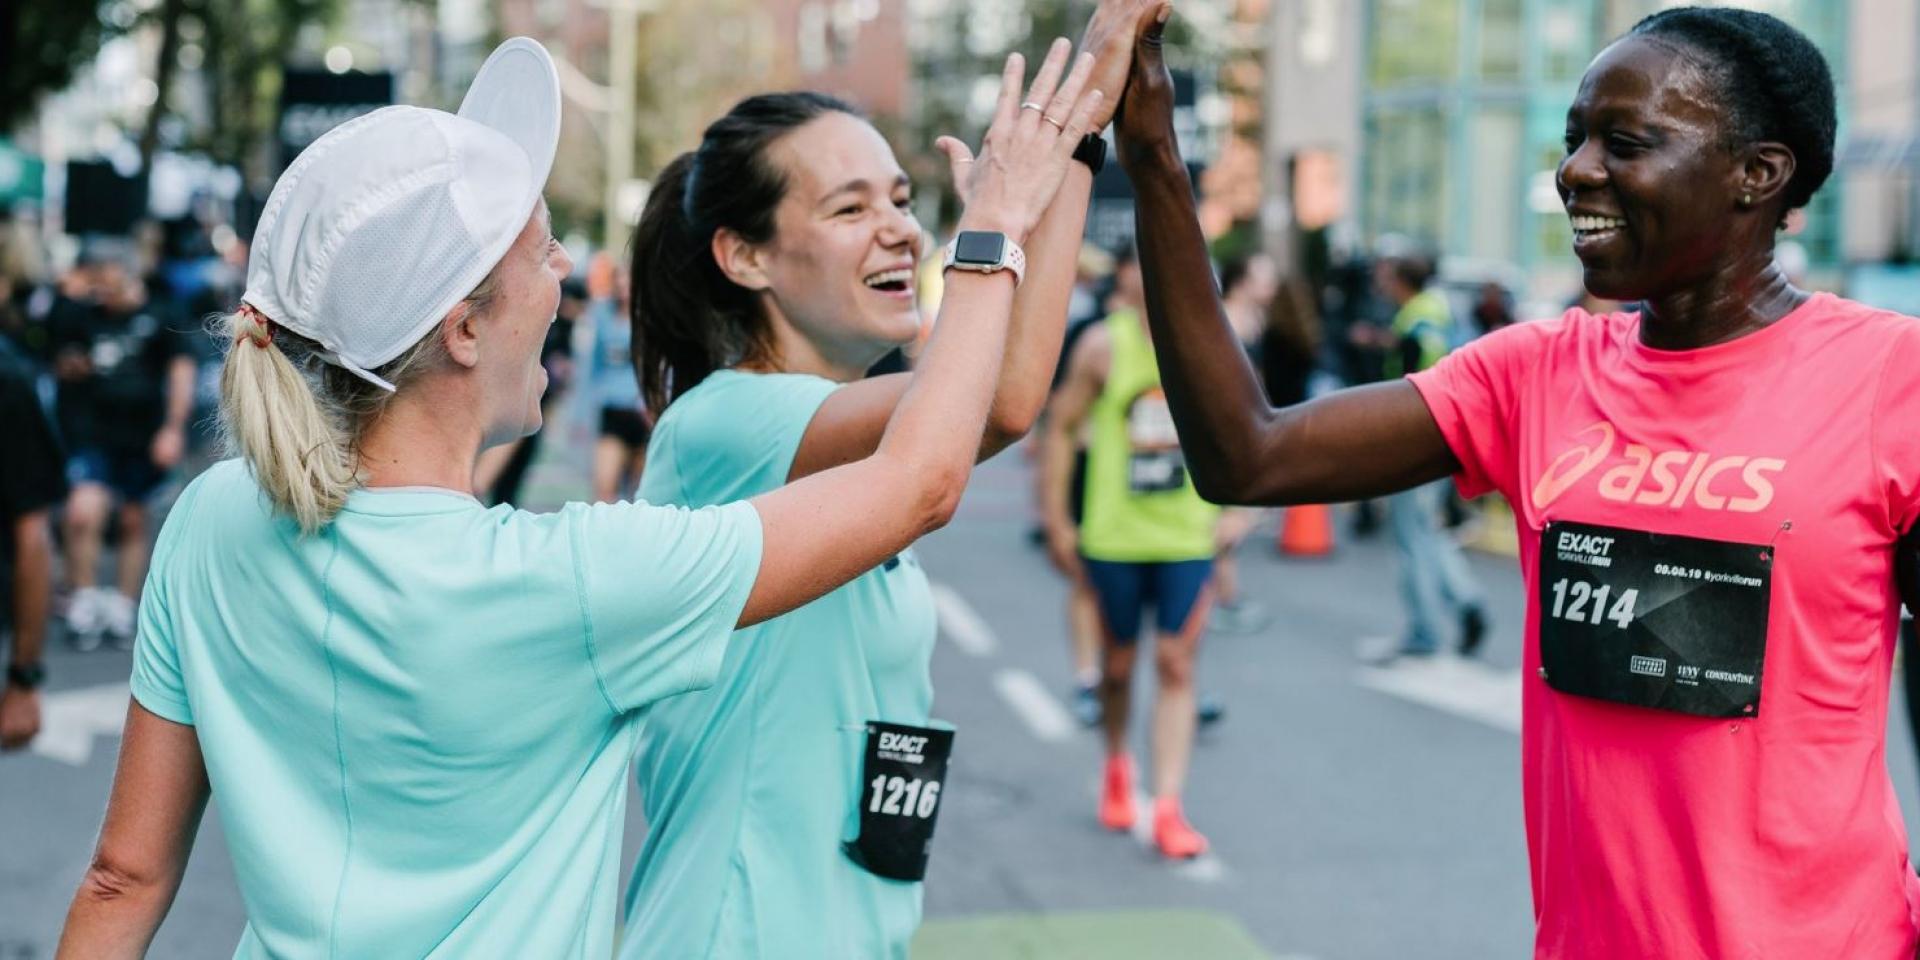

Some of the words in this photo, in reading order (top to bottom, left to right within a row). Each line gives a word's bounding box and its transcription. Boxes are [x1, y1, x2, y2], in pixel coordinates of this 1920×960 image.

[1557, 531, 1615, 556] EXACT
[1552, 577, 1640, 630] 1214
[878, 731, 929, 754] EXACT
[869, 773, 940, 819] 1216
